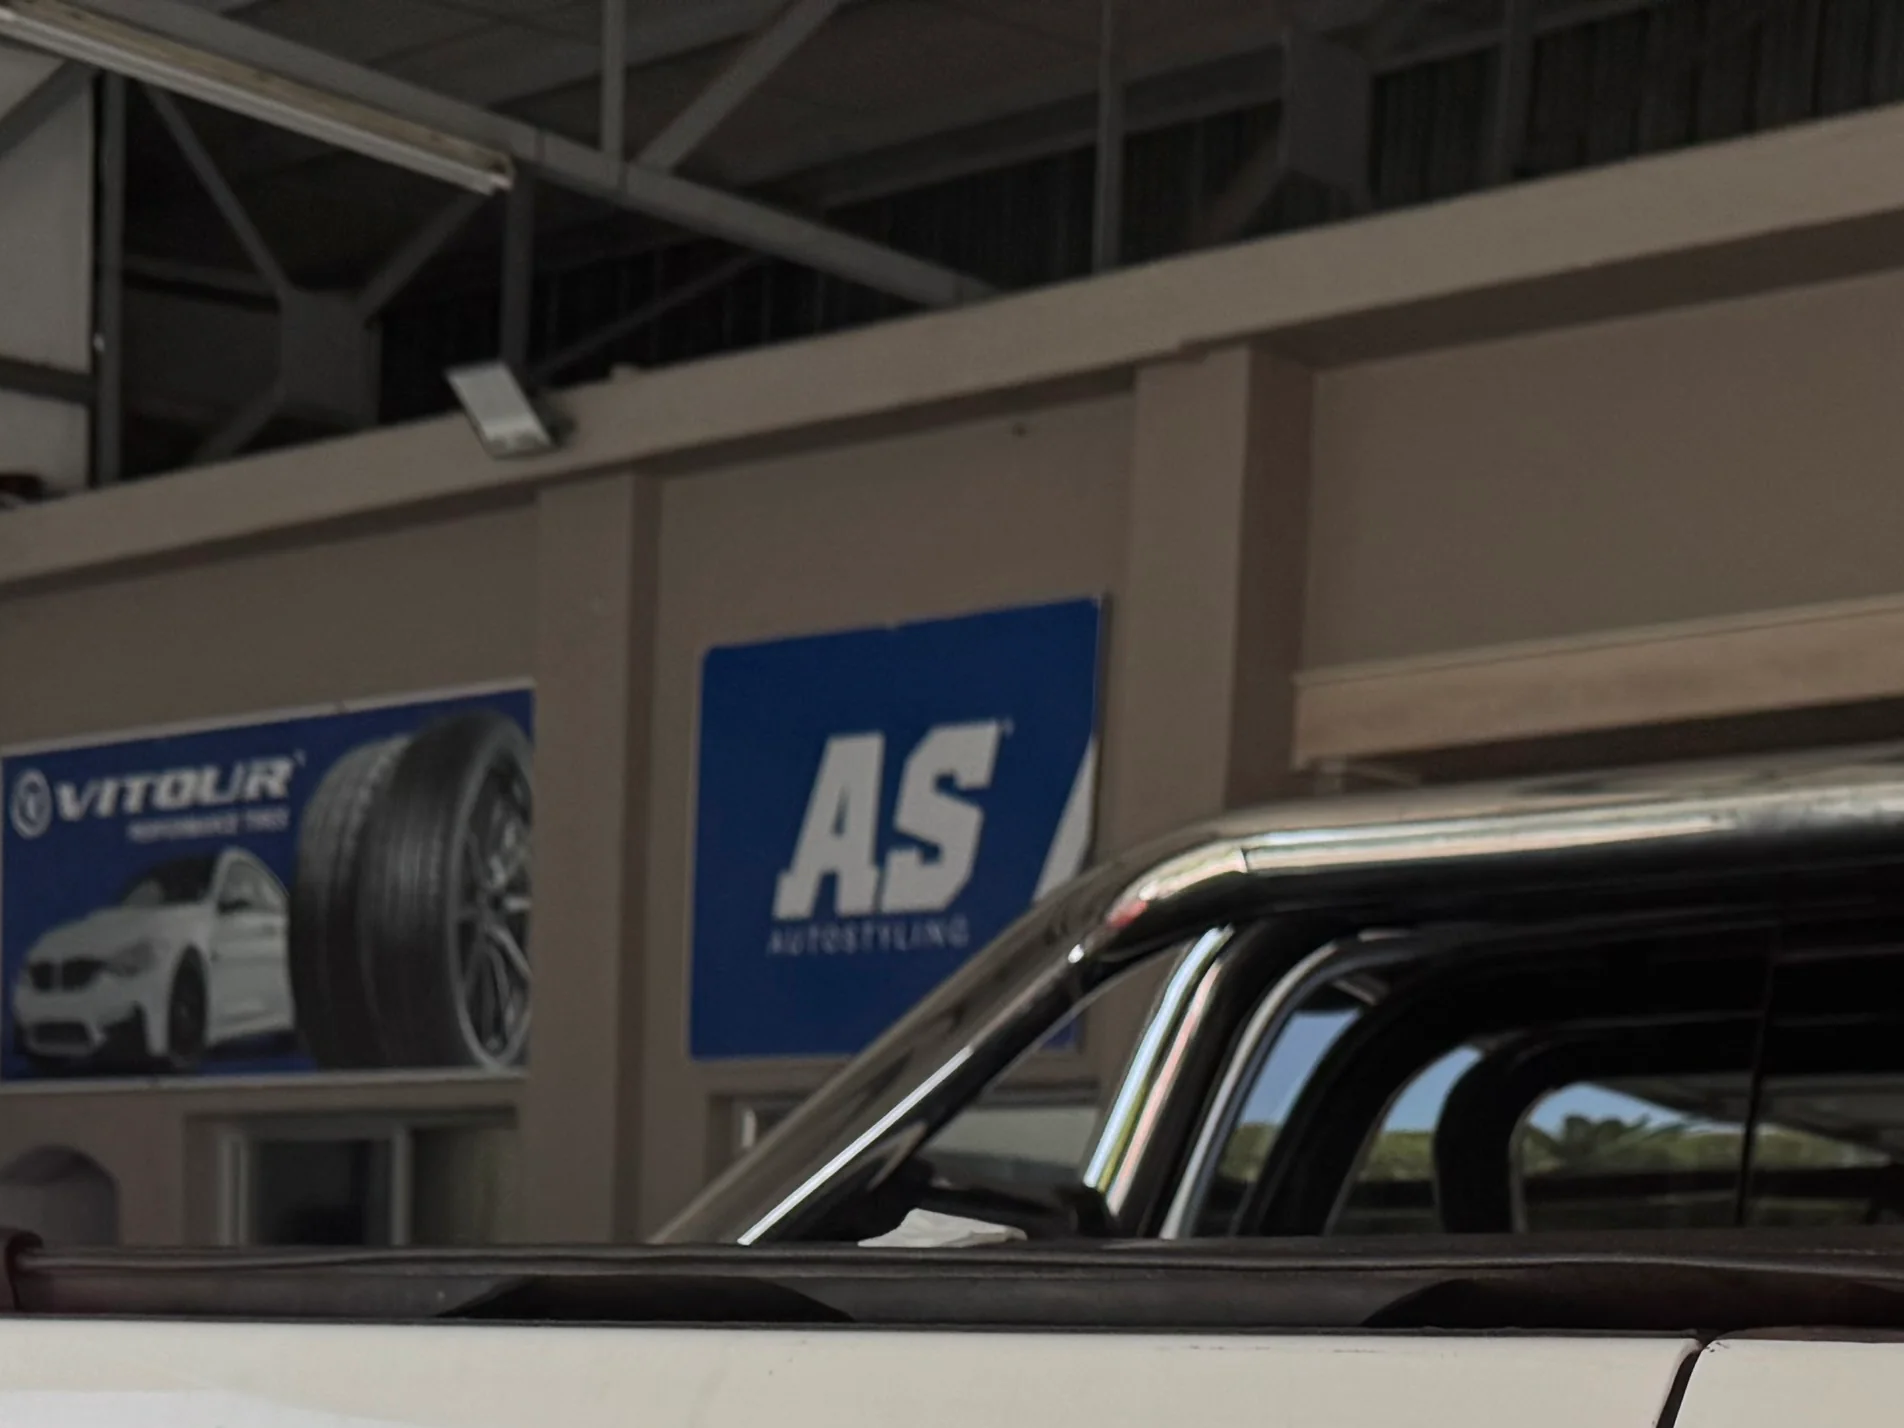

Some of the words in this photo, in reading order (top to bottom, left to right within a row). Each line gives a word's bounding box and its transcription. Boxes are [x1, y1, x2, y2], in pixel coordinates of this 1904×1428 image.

[54, 757, 294, 822] VITOUR
[772, 719, 1001, 919] AS
[766, 914, 970, 956] AUTOSTYLING
